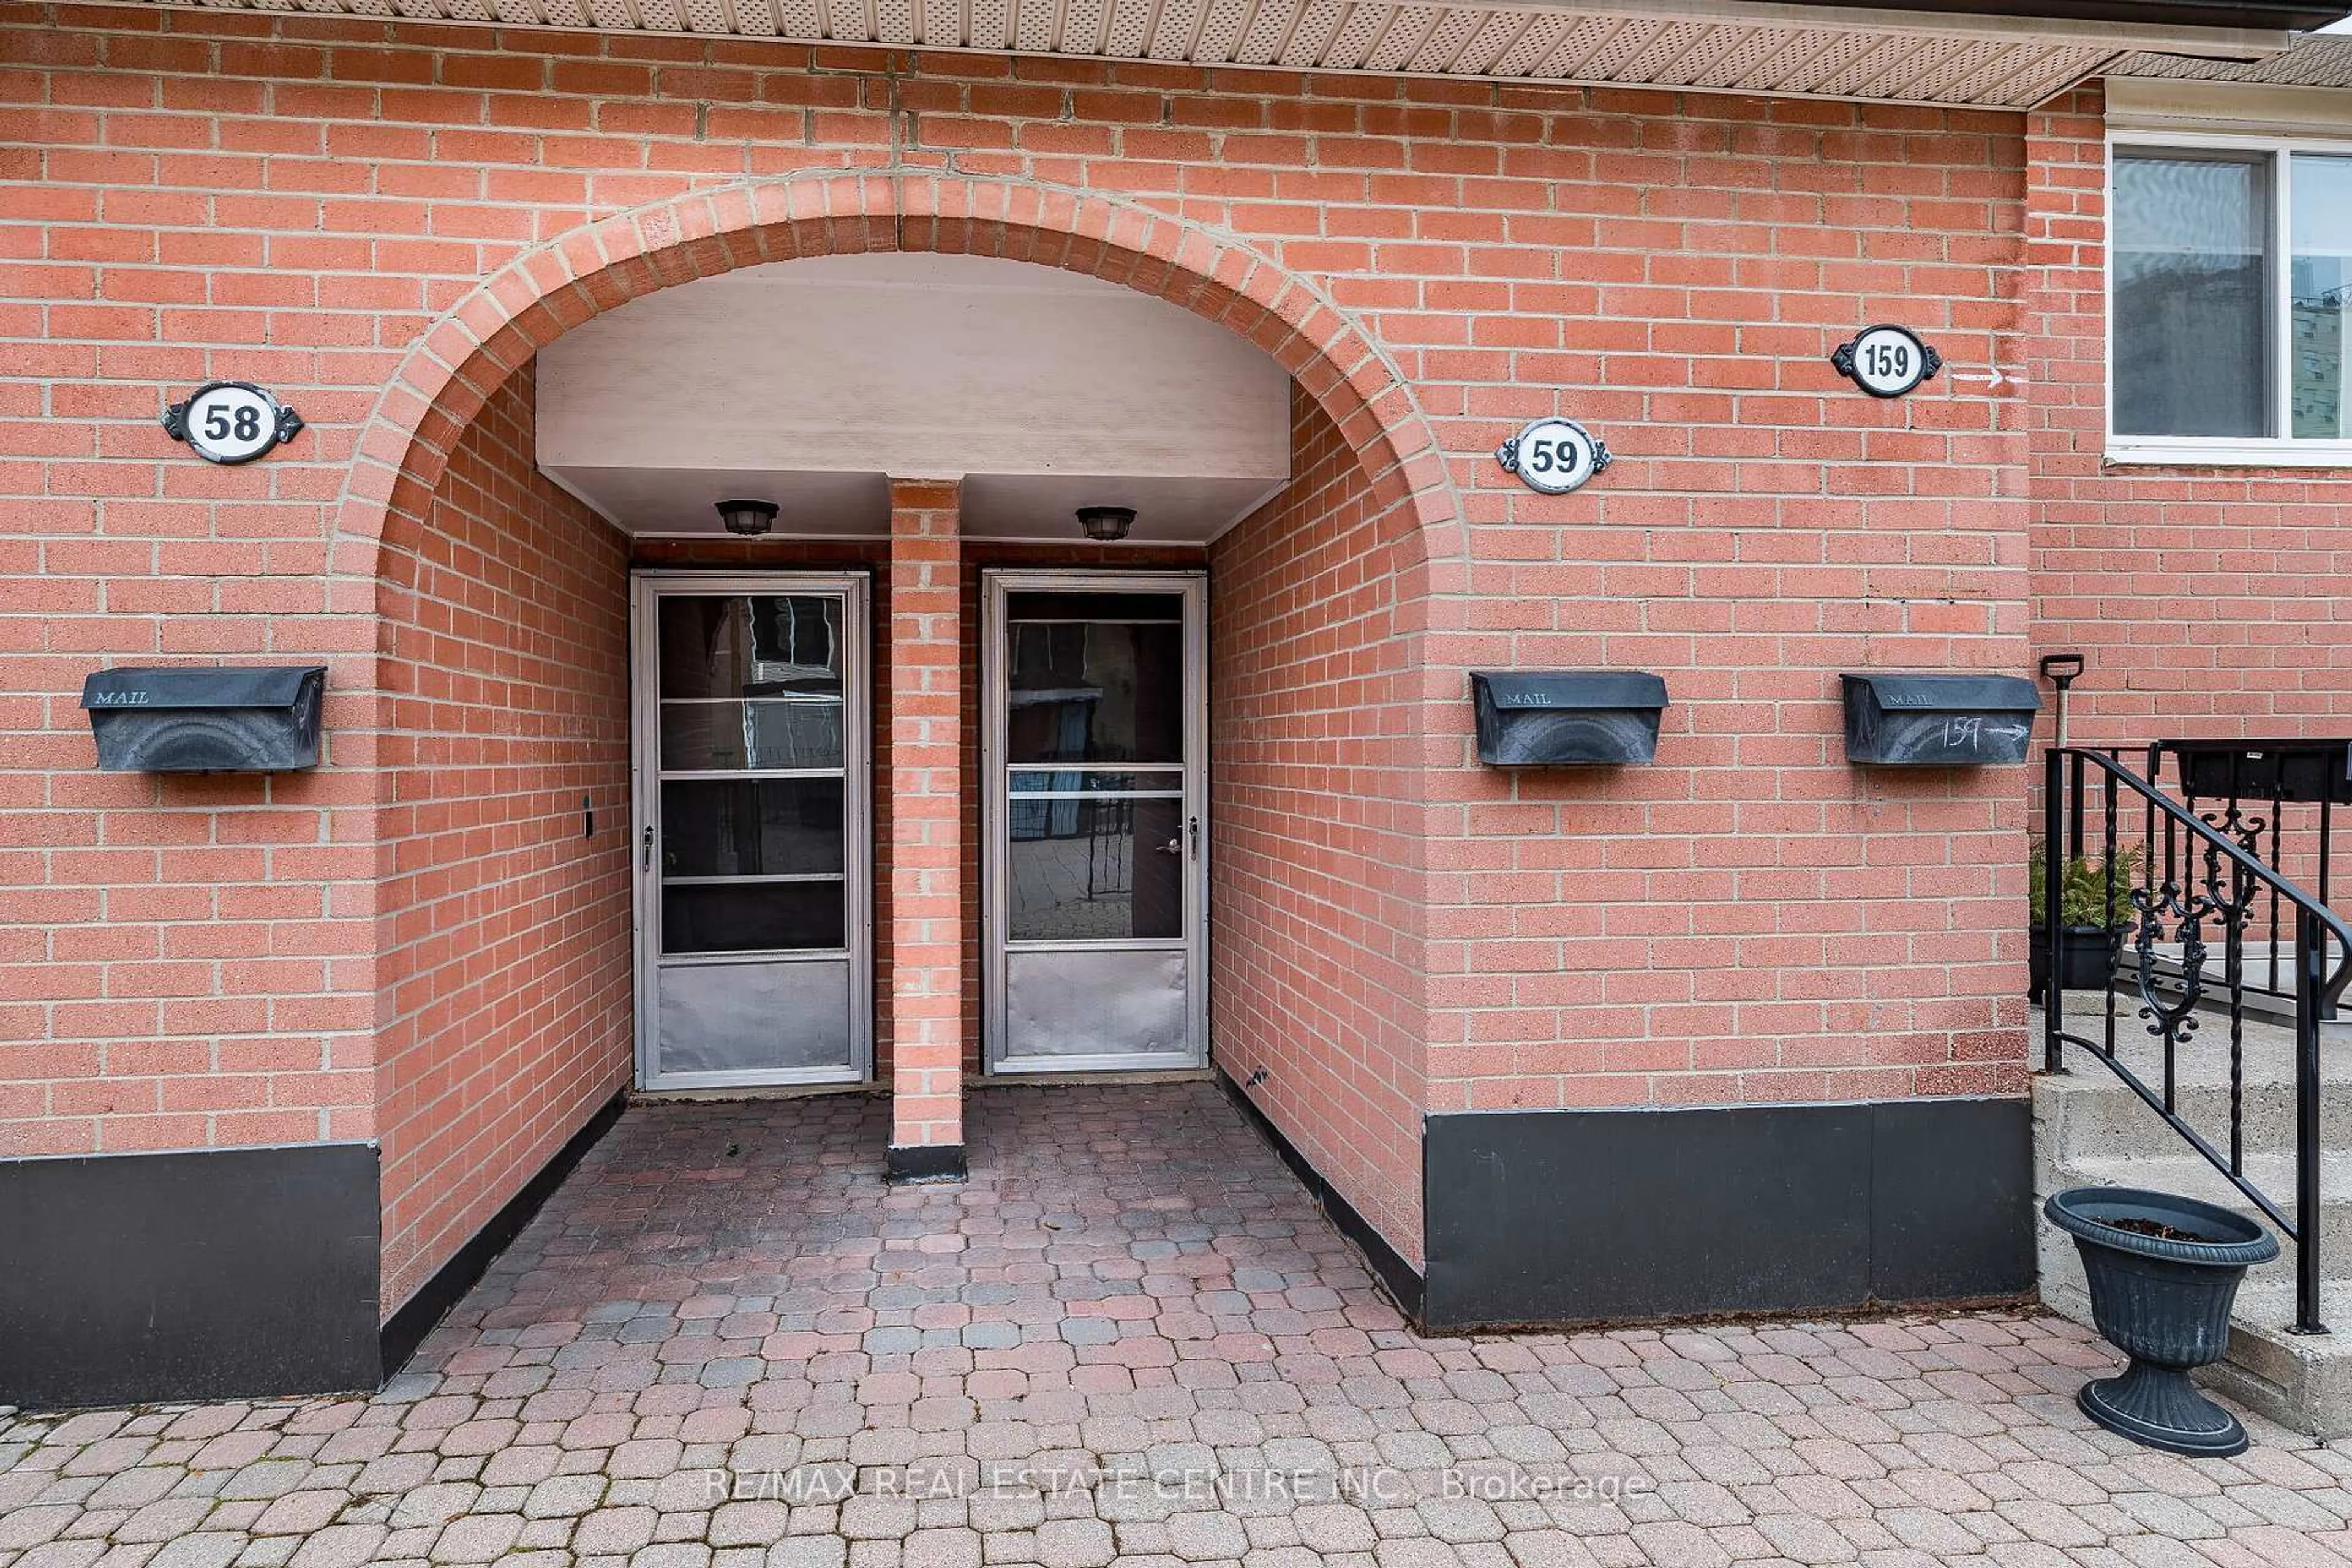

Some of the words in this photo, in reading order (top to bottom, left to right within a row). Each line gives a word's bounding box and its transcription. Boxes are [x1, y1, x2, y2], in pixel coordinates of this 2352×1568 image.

[1865, 344, 1909, 377] 159
[205, 405, 260, 441] 58
[1532, 440, 1577, 473] 59
[94, 691, 149, 705] MAIL
[1506, 693, 1552, 705] MAIL
[1887, 695, 1933, 705] MAIL
[1943, 717, 1983, 753] 159
